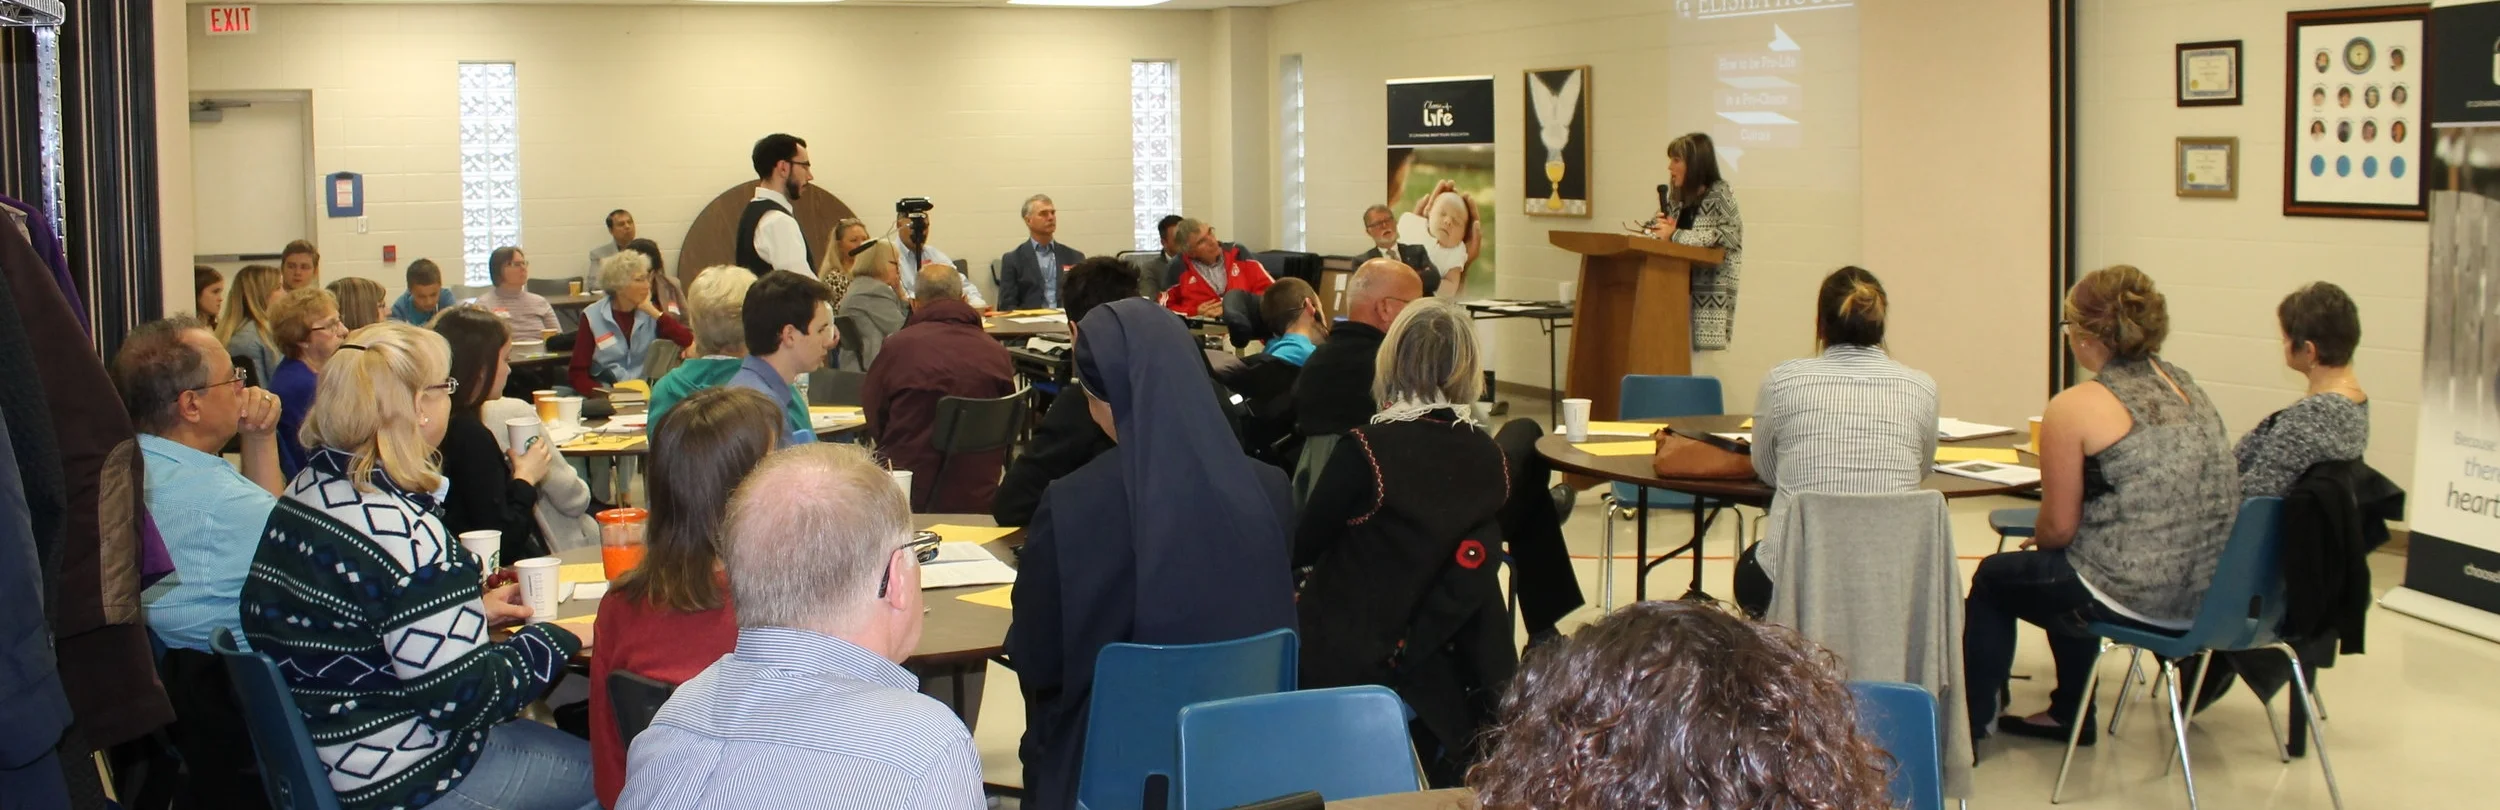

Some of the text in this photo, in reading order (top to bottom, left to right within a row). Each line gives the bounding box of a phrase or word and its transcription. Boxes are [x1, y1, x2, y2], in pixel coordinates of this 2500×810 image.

[211, 7, 251, 32] EXIT
[1424, 108, 1454, 127] Life
[2454, 431, 2496, 452] Because
